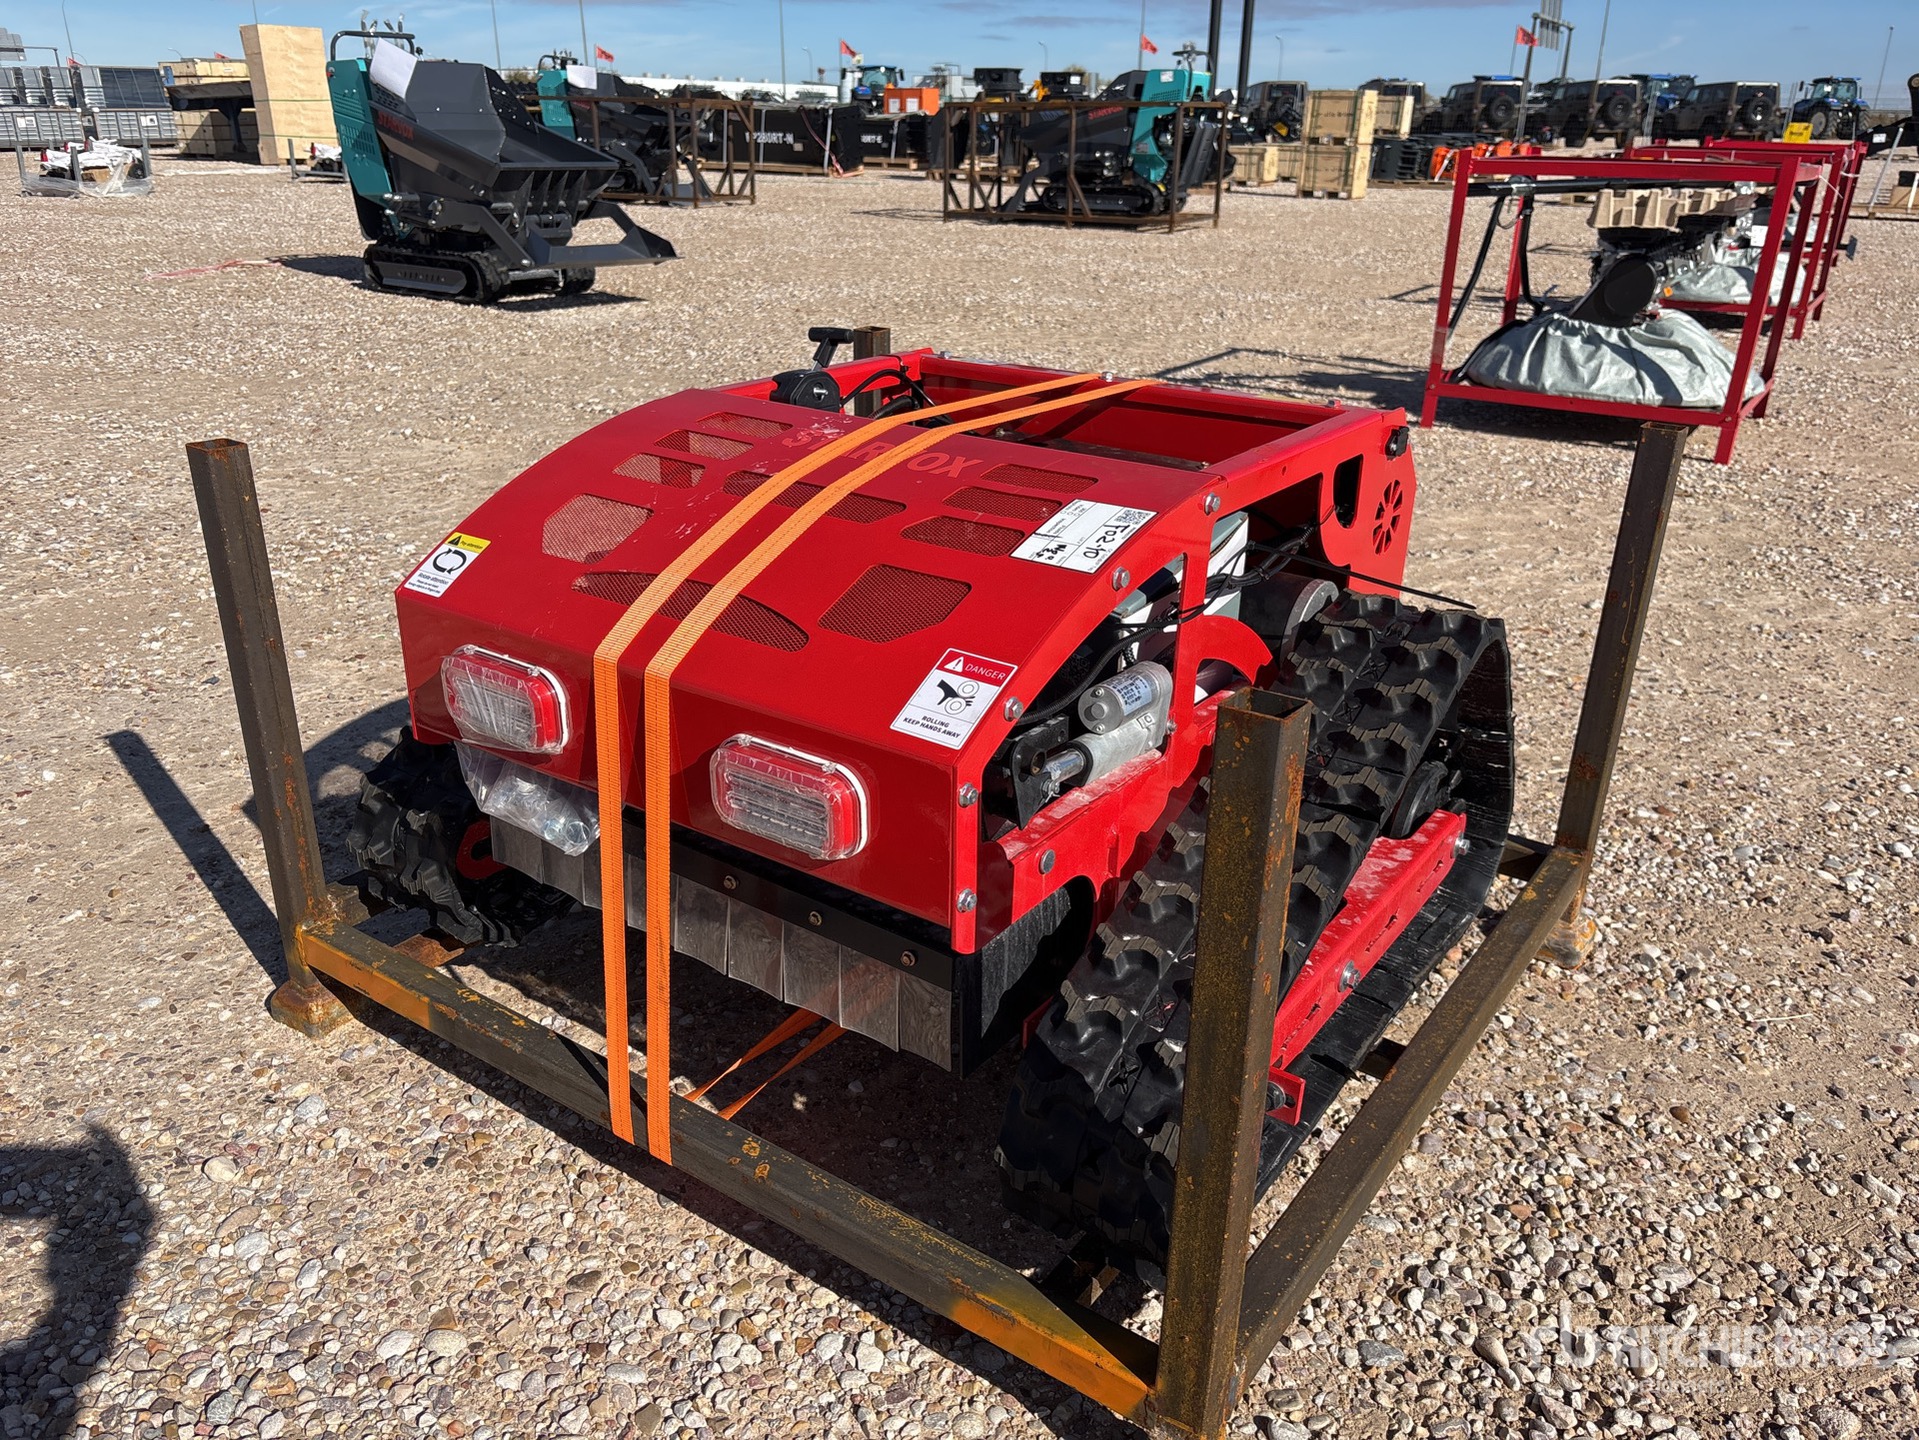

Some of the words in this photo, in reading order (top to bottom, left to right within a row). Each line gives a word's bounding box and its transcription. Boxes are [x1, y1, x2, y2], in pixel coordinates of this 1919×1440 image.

[965, 663, 1006, 680] DANGER
[902, 717, 920, 727] KEEP
[920, 722, 942, 733] HANDS
[942, 728, 961, 739] AWAY
[922, 715, 950, 728] ROLLING
